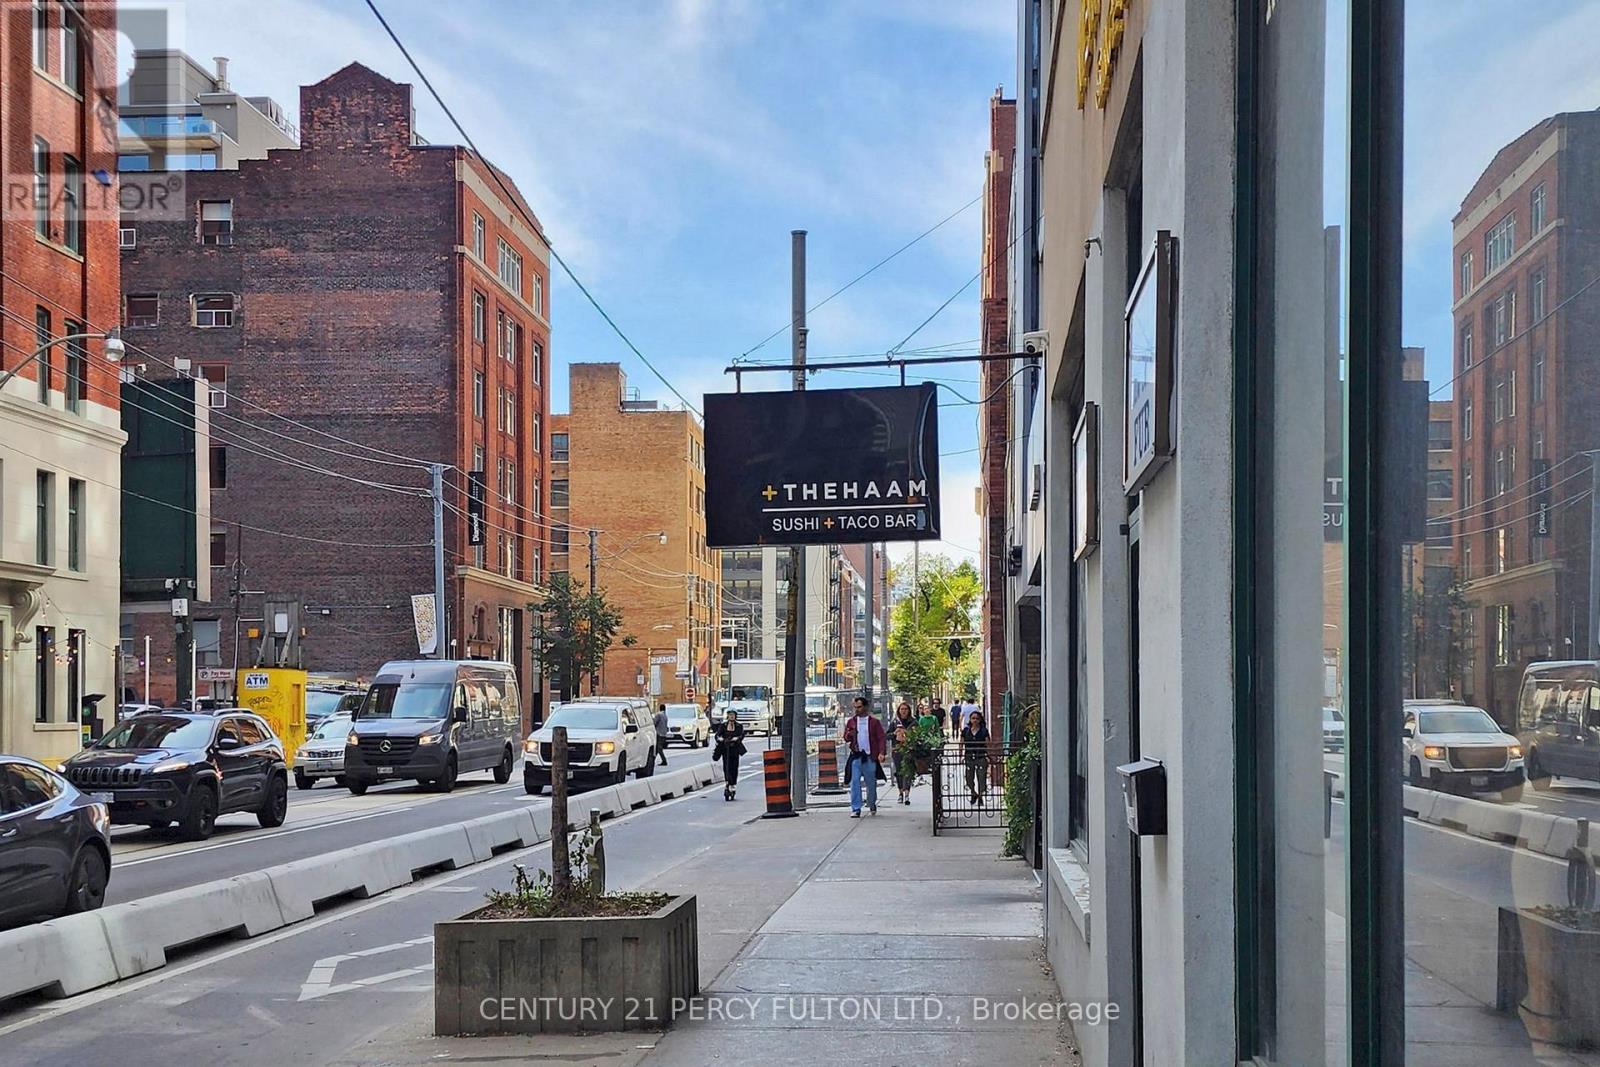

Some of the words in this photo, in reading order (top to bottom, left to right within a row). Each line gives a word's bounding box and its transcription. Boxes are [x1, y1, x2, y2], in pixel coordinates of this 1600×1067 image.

[783, 480, 926, 500] THEHAAM
[772, 517, 820, 532] SUSHI
[838, 514, 880, 529] TACO
[884, 513, 917, 528] BAR
[246, 676, 268, 685] ATM
